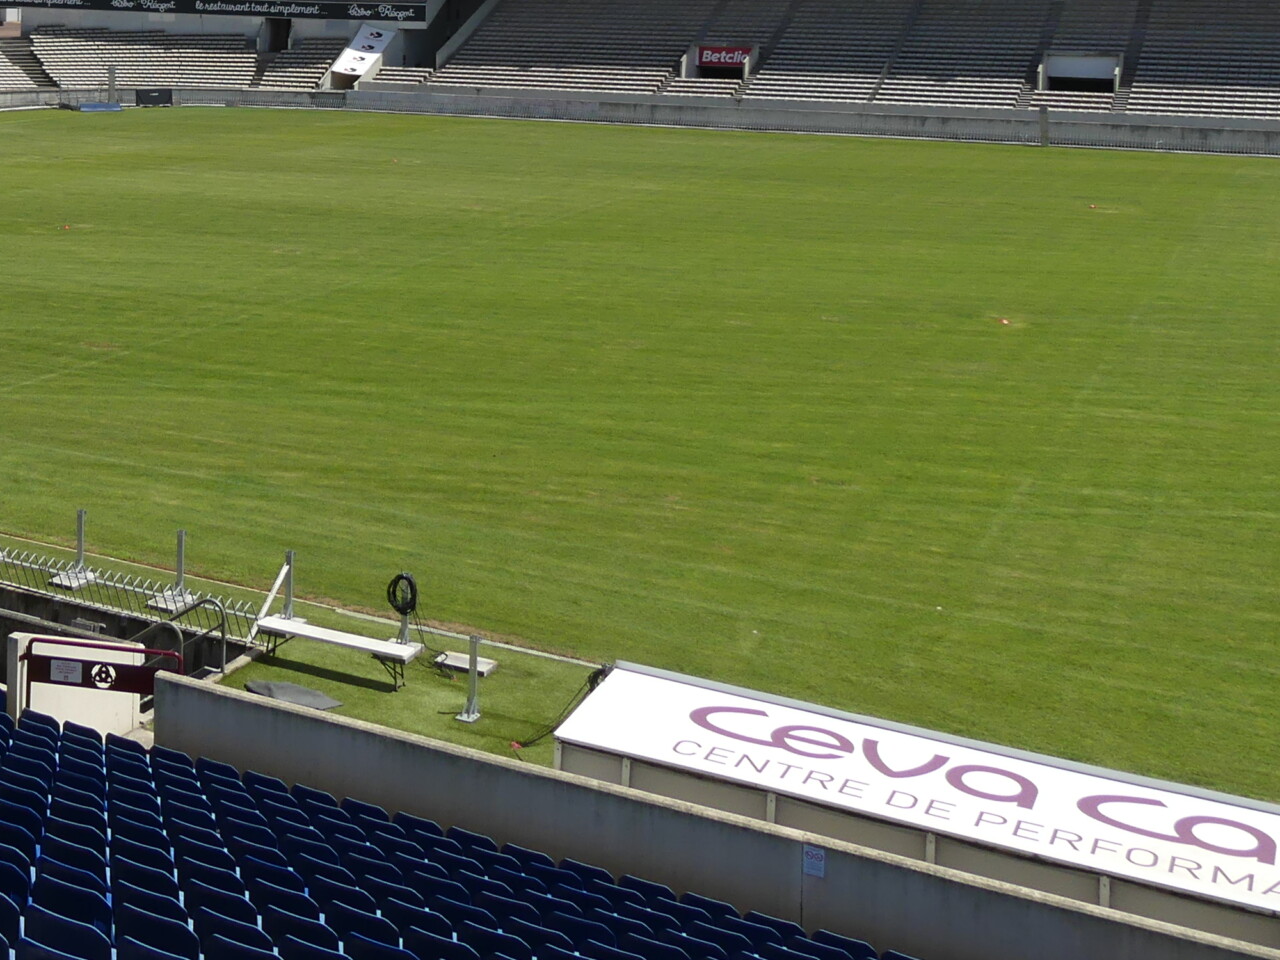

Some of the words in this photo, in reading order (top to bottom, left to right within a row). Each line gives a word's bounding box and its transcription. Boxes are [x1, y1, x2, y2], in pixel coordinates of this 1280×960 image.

[195, 0, 205, 10] le
[205, 1, 251, 11] restaurant
[251, 2, 270, 12] tout
[269, 3, 320, 16] simplement
[672, 739, 870, 799] CENTRE
[885, 789, 957, 821] DE
[689, 706, 1039, 810] ceva
